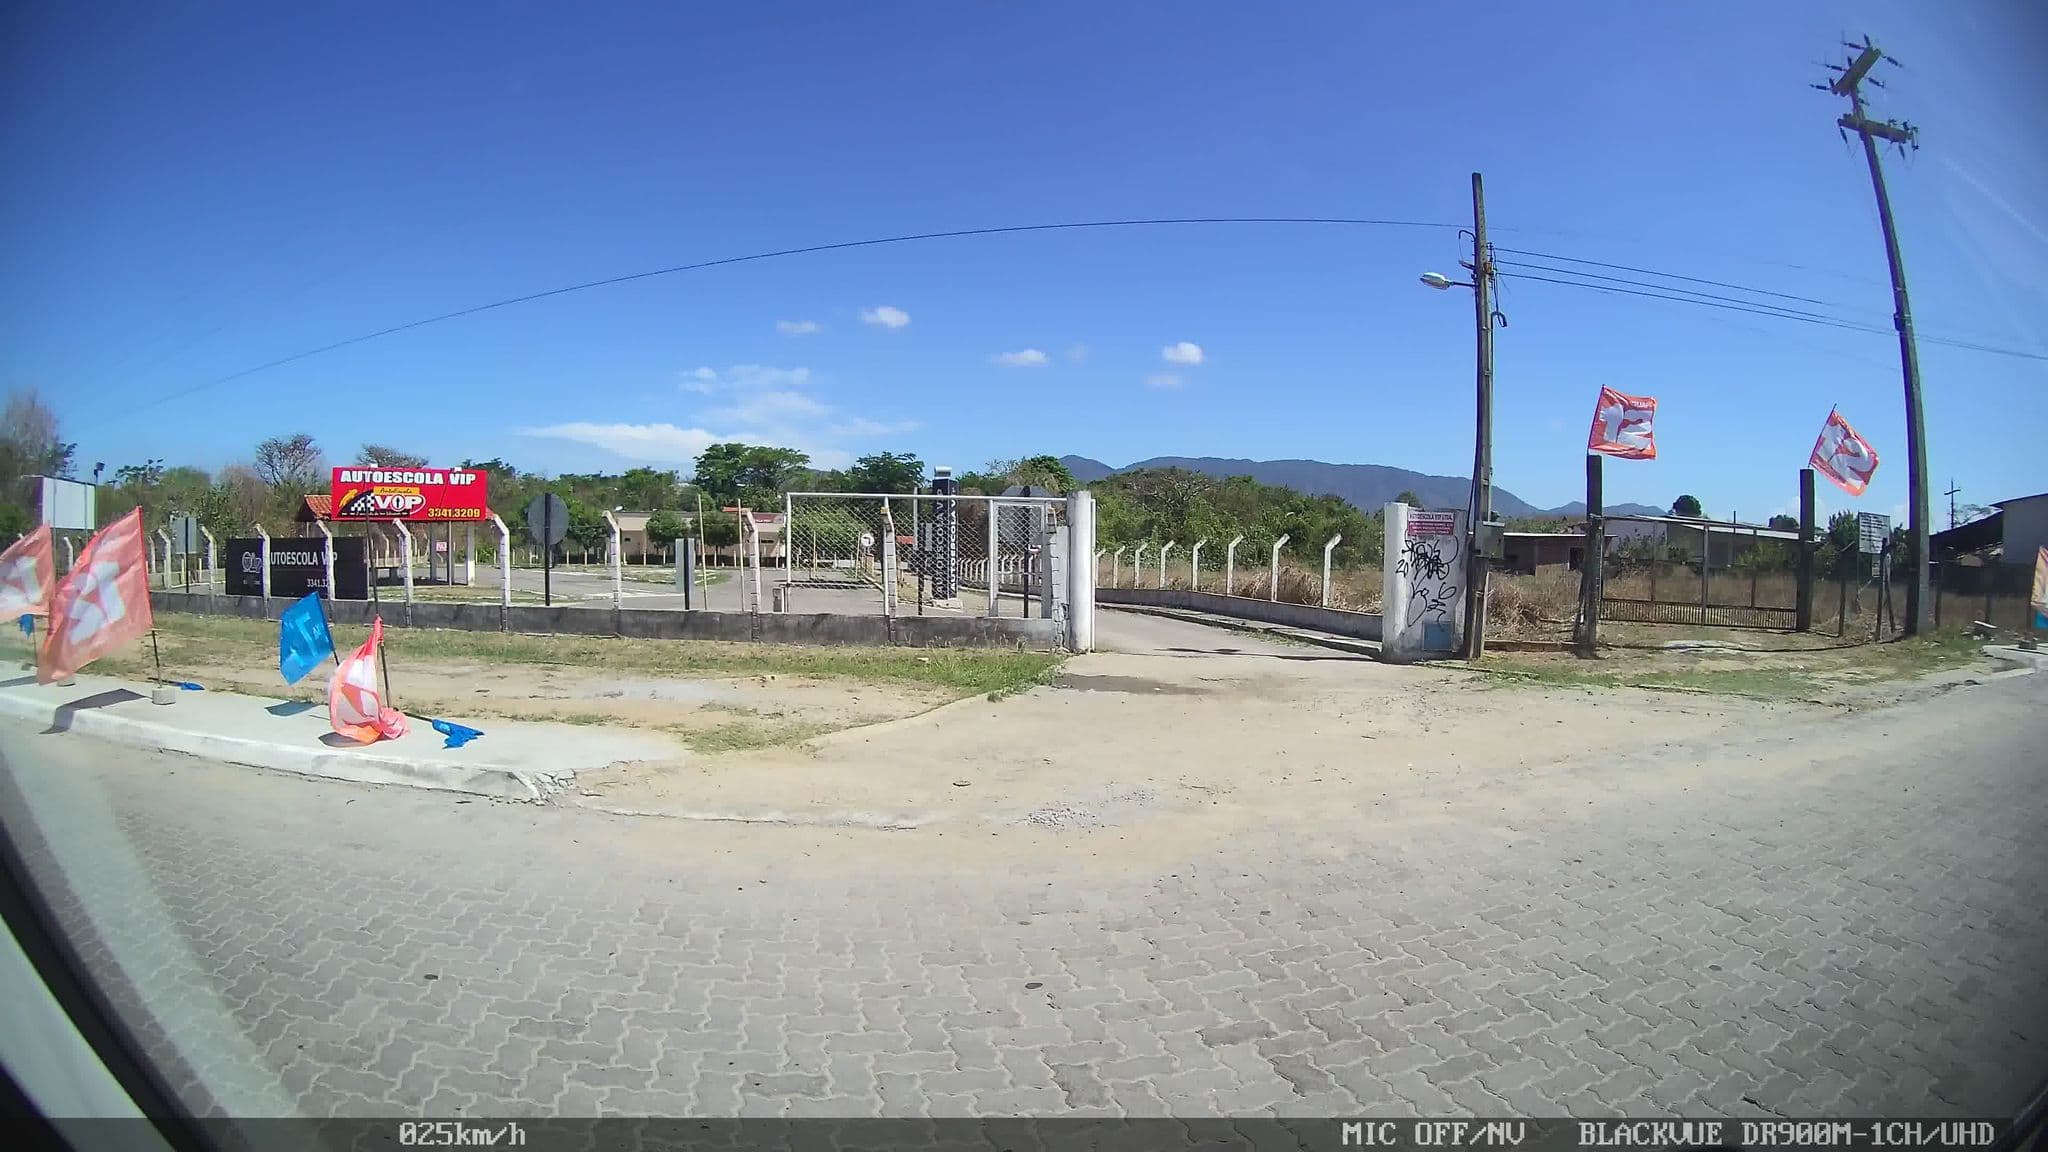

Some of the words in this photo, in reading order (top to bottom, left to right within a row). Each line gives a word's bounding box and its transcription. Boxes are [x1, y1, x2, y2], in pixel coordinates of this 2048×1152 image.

[340, 470, 444, 484] AUTOESCOLA
[449, 473, 476, 485] VIP
[428, 508, 480, 518] 3341.3209
[270, 551, 318, 566] UTOESCOLA
